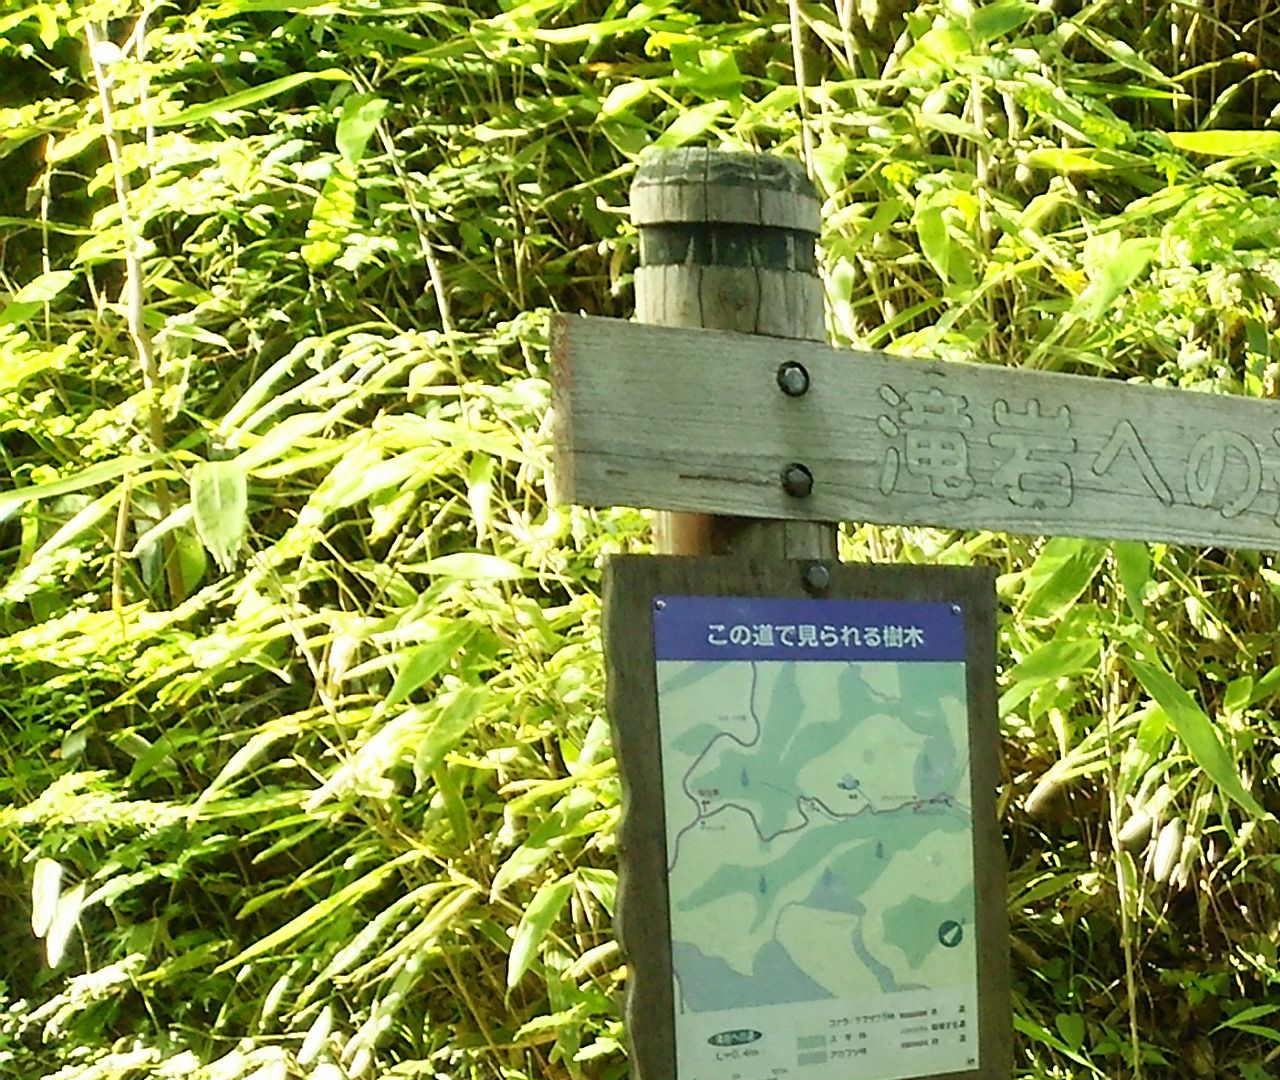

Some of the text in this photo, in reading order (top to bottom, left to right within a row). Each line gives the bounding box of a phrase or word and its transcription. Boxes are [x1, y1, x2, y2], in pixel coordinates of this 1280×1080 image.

[707, 624, 924, 649] この道で見られる樹木
